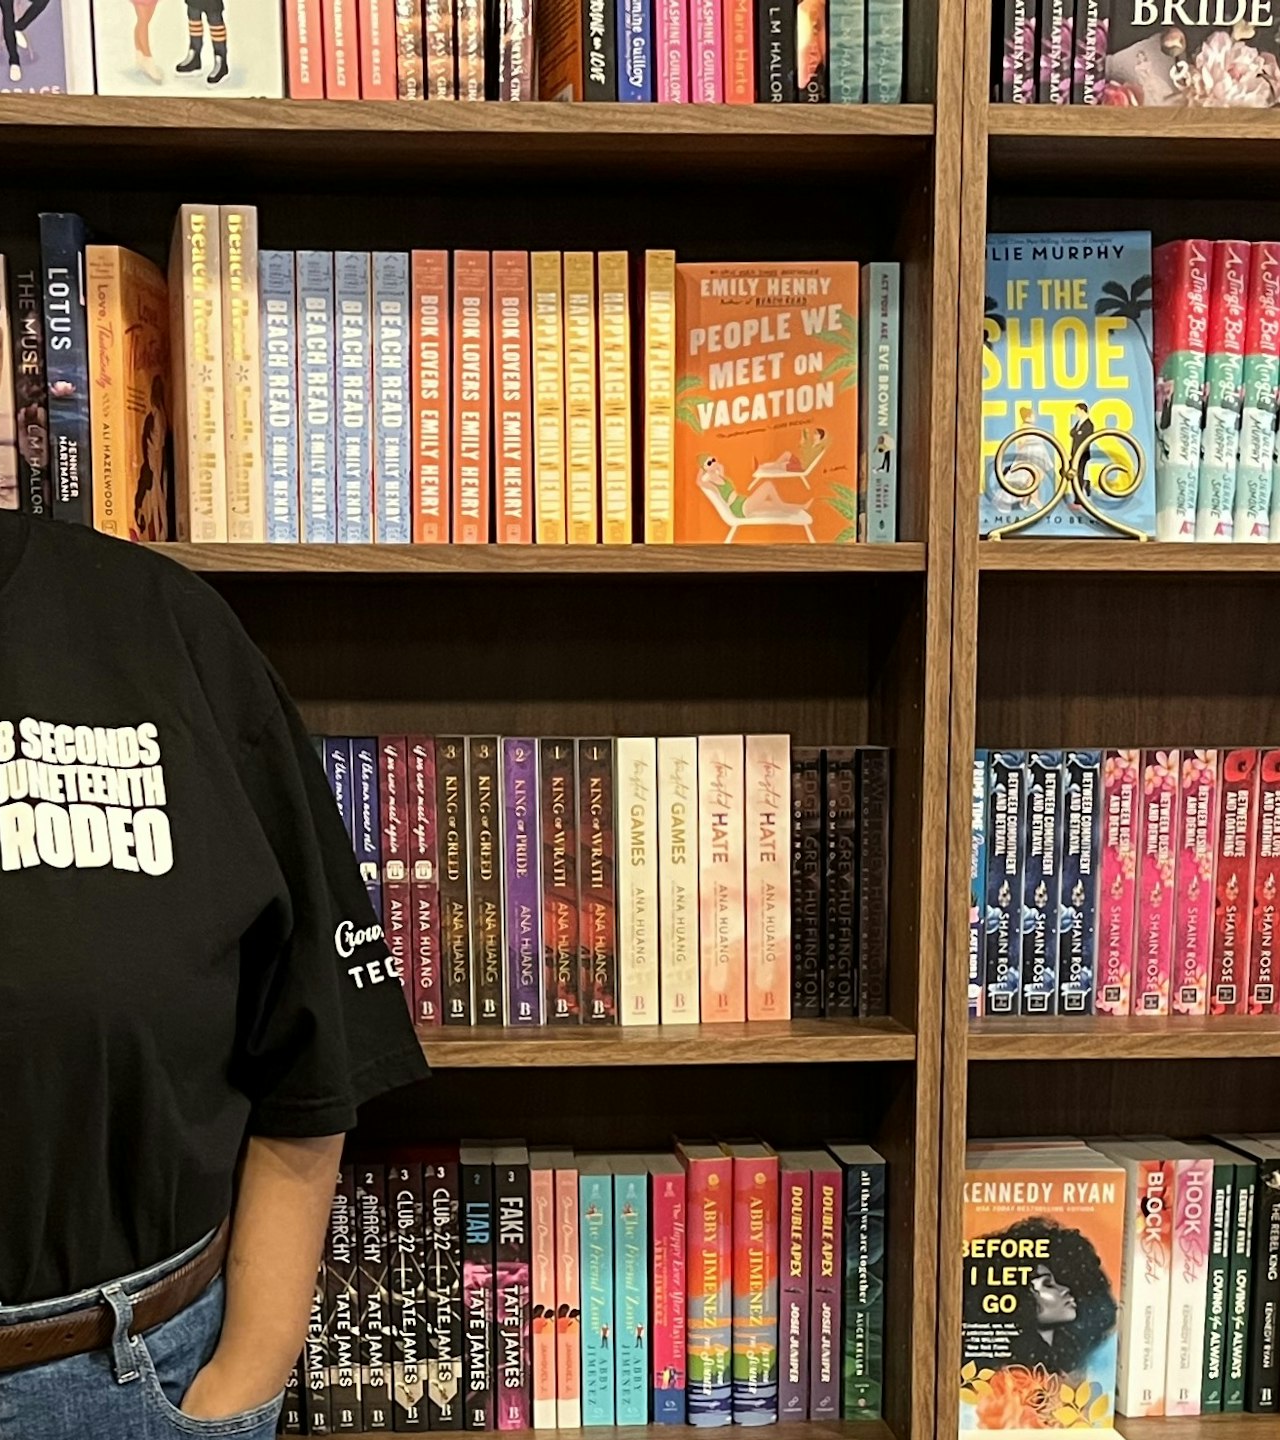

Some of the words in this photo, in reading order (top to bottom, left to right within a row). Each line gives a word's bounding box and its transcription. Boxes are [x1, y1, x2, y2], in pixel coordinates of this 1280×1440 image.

[1032, 246, 1124, 261] MURPHY
[1188, 249, 1207, 268] A
[47, 268, 71, 350] LOTUS
[700, 279, 758, 296] EMILY
[767, 277, 831, 296] HENRY
[1006, 280, 1030, 309] IF
[1037, 279, 1088, 309] THE
[1188, 270, 1208, 319] Jingle
[421, 295, 439, 340] BOOK
[690, 311, 794, 355] PEOPLE
[800, 305, 842, 338] WE
[1188, 319, 1207, 354] Bell
[420, 342, 438, 400] LOVERS
[709, 354, 784, 390] MEET
[794, 354, 824, 376] ON
[1185, 355, 1205, 408] Mingle
[696, 384, 834, 431] VACATION
[421, 409, 438, 458] EMILY
[421, 461, 440, 518] HENRY
[20, 717, 160, 767] SECONDS
[630, 804, 644, 866] GAMES
[712, 814, 729, 862] HATE
[334, 920, 385, 958] Crow
[1063, 1183, 1114, 1203] RYAN
[1146, 1171, 1163, 1240] BLOCK
[466, 1202, 488, 1245] LIAR
[500, 1196, 524, 1245] FAKE
[703, 1197, 718, 1244] ABBY
[703, 1250, 719, 1327] JIMENEZ
[970, 1267, 978, 1286] I
[987, 1267, 1033, 1285] LET
[504, 1284, 520, 1326] TATE
[983, 1296, 1017, 1314] GO
[504, 1326, 520, 1389] JAMES
